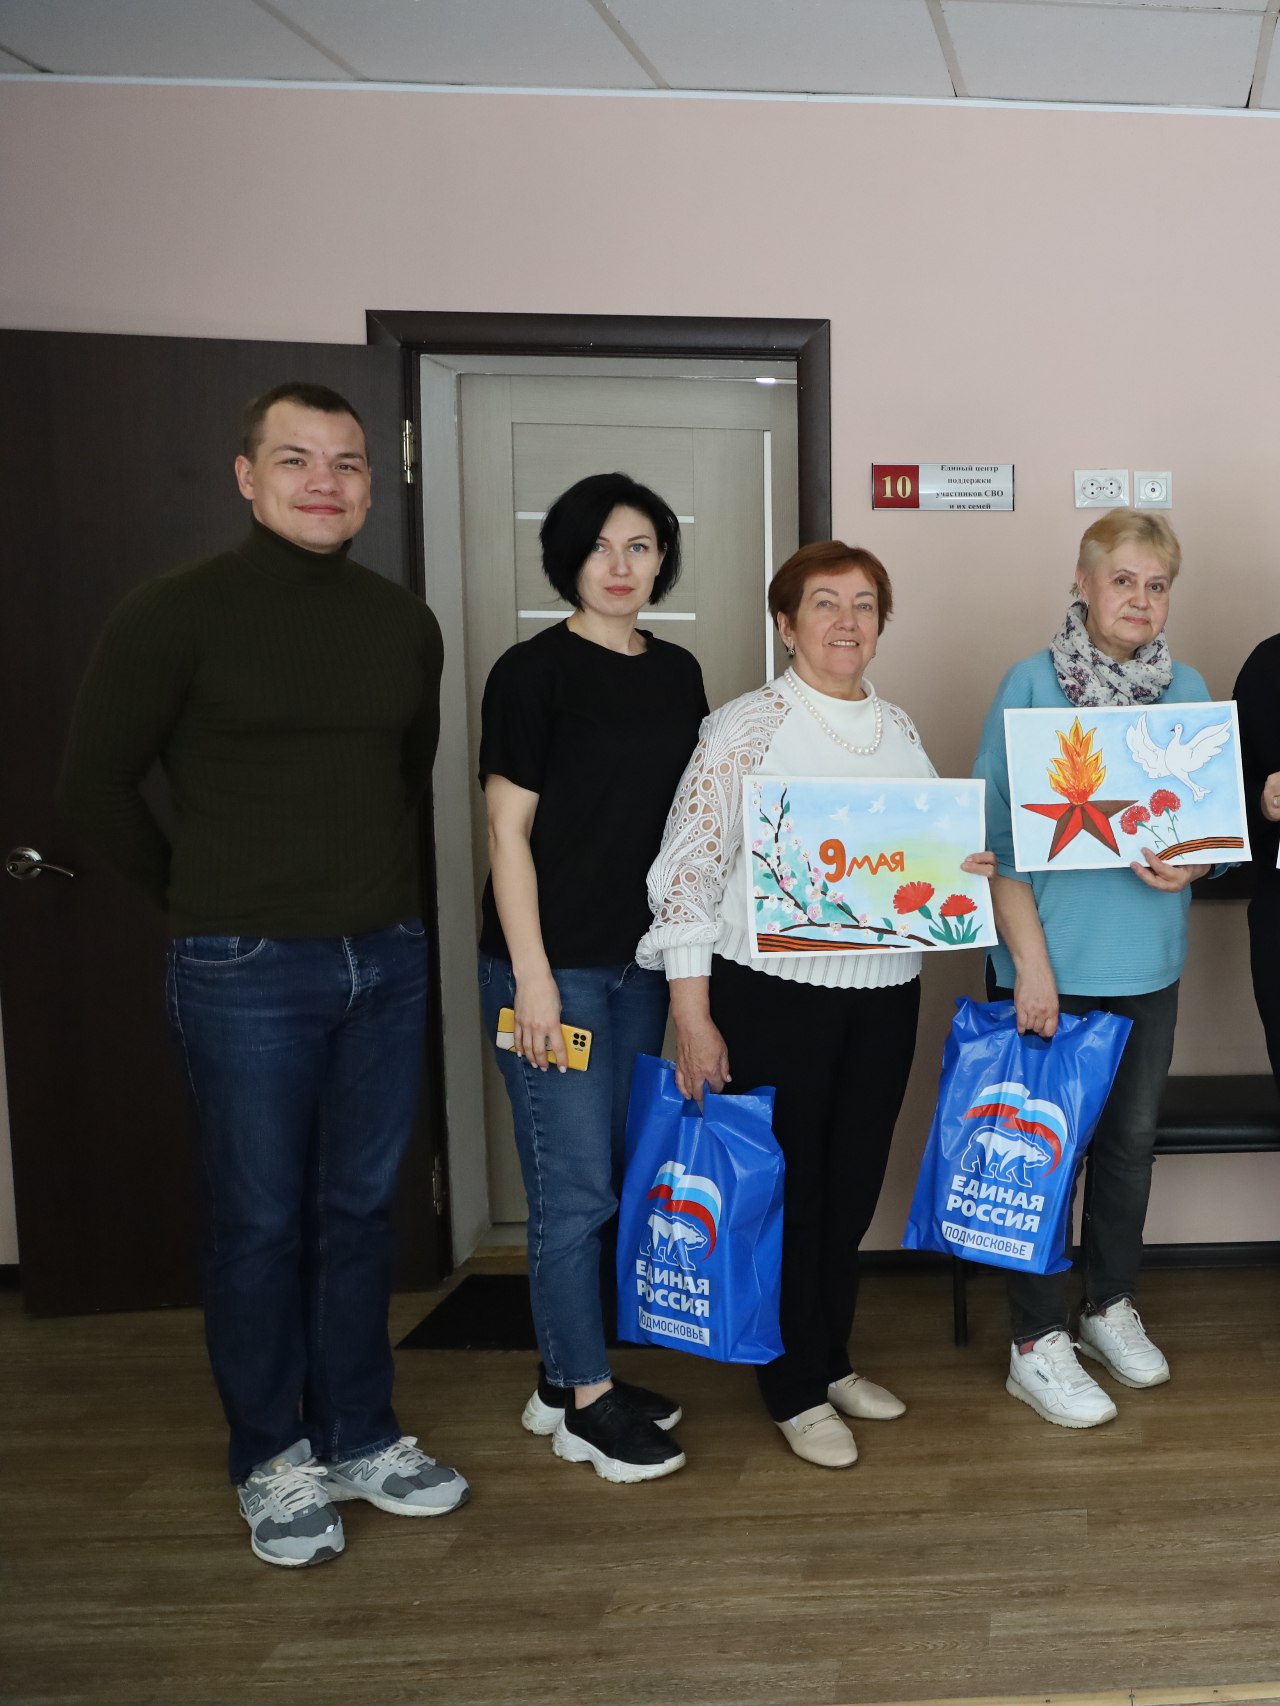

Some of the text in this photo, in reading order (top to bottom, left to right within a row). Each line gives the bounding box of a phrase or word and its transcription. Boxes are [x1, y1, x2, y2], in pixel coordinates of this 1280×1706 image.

[881, 475, 912, 499] 10
[940, 464, 999, 473] Единый центр
[935, 489, 1004, 499] участников СВО
[818, 838, 847, 883] 9
[950, 1174, 1045, 1212] ЕДИНАЯ
[946, 1194, 1041, 1233] РОССИЯ
[944, 1225, 1028, 1256] ПОДМОСКОВЬЕ
[635, 1259, 710, 1296] ЕДИНАЯ
[636, 1280, 710, 1318] РОССИЯ
